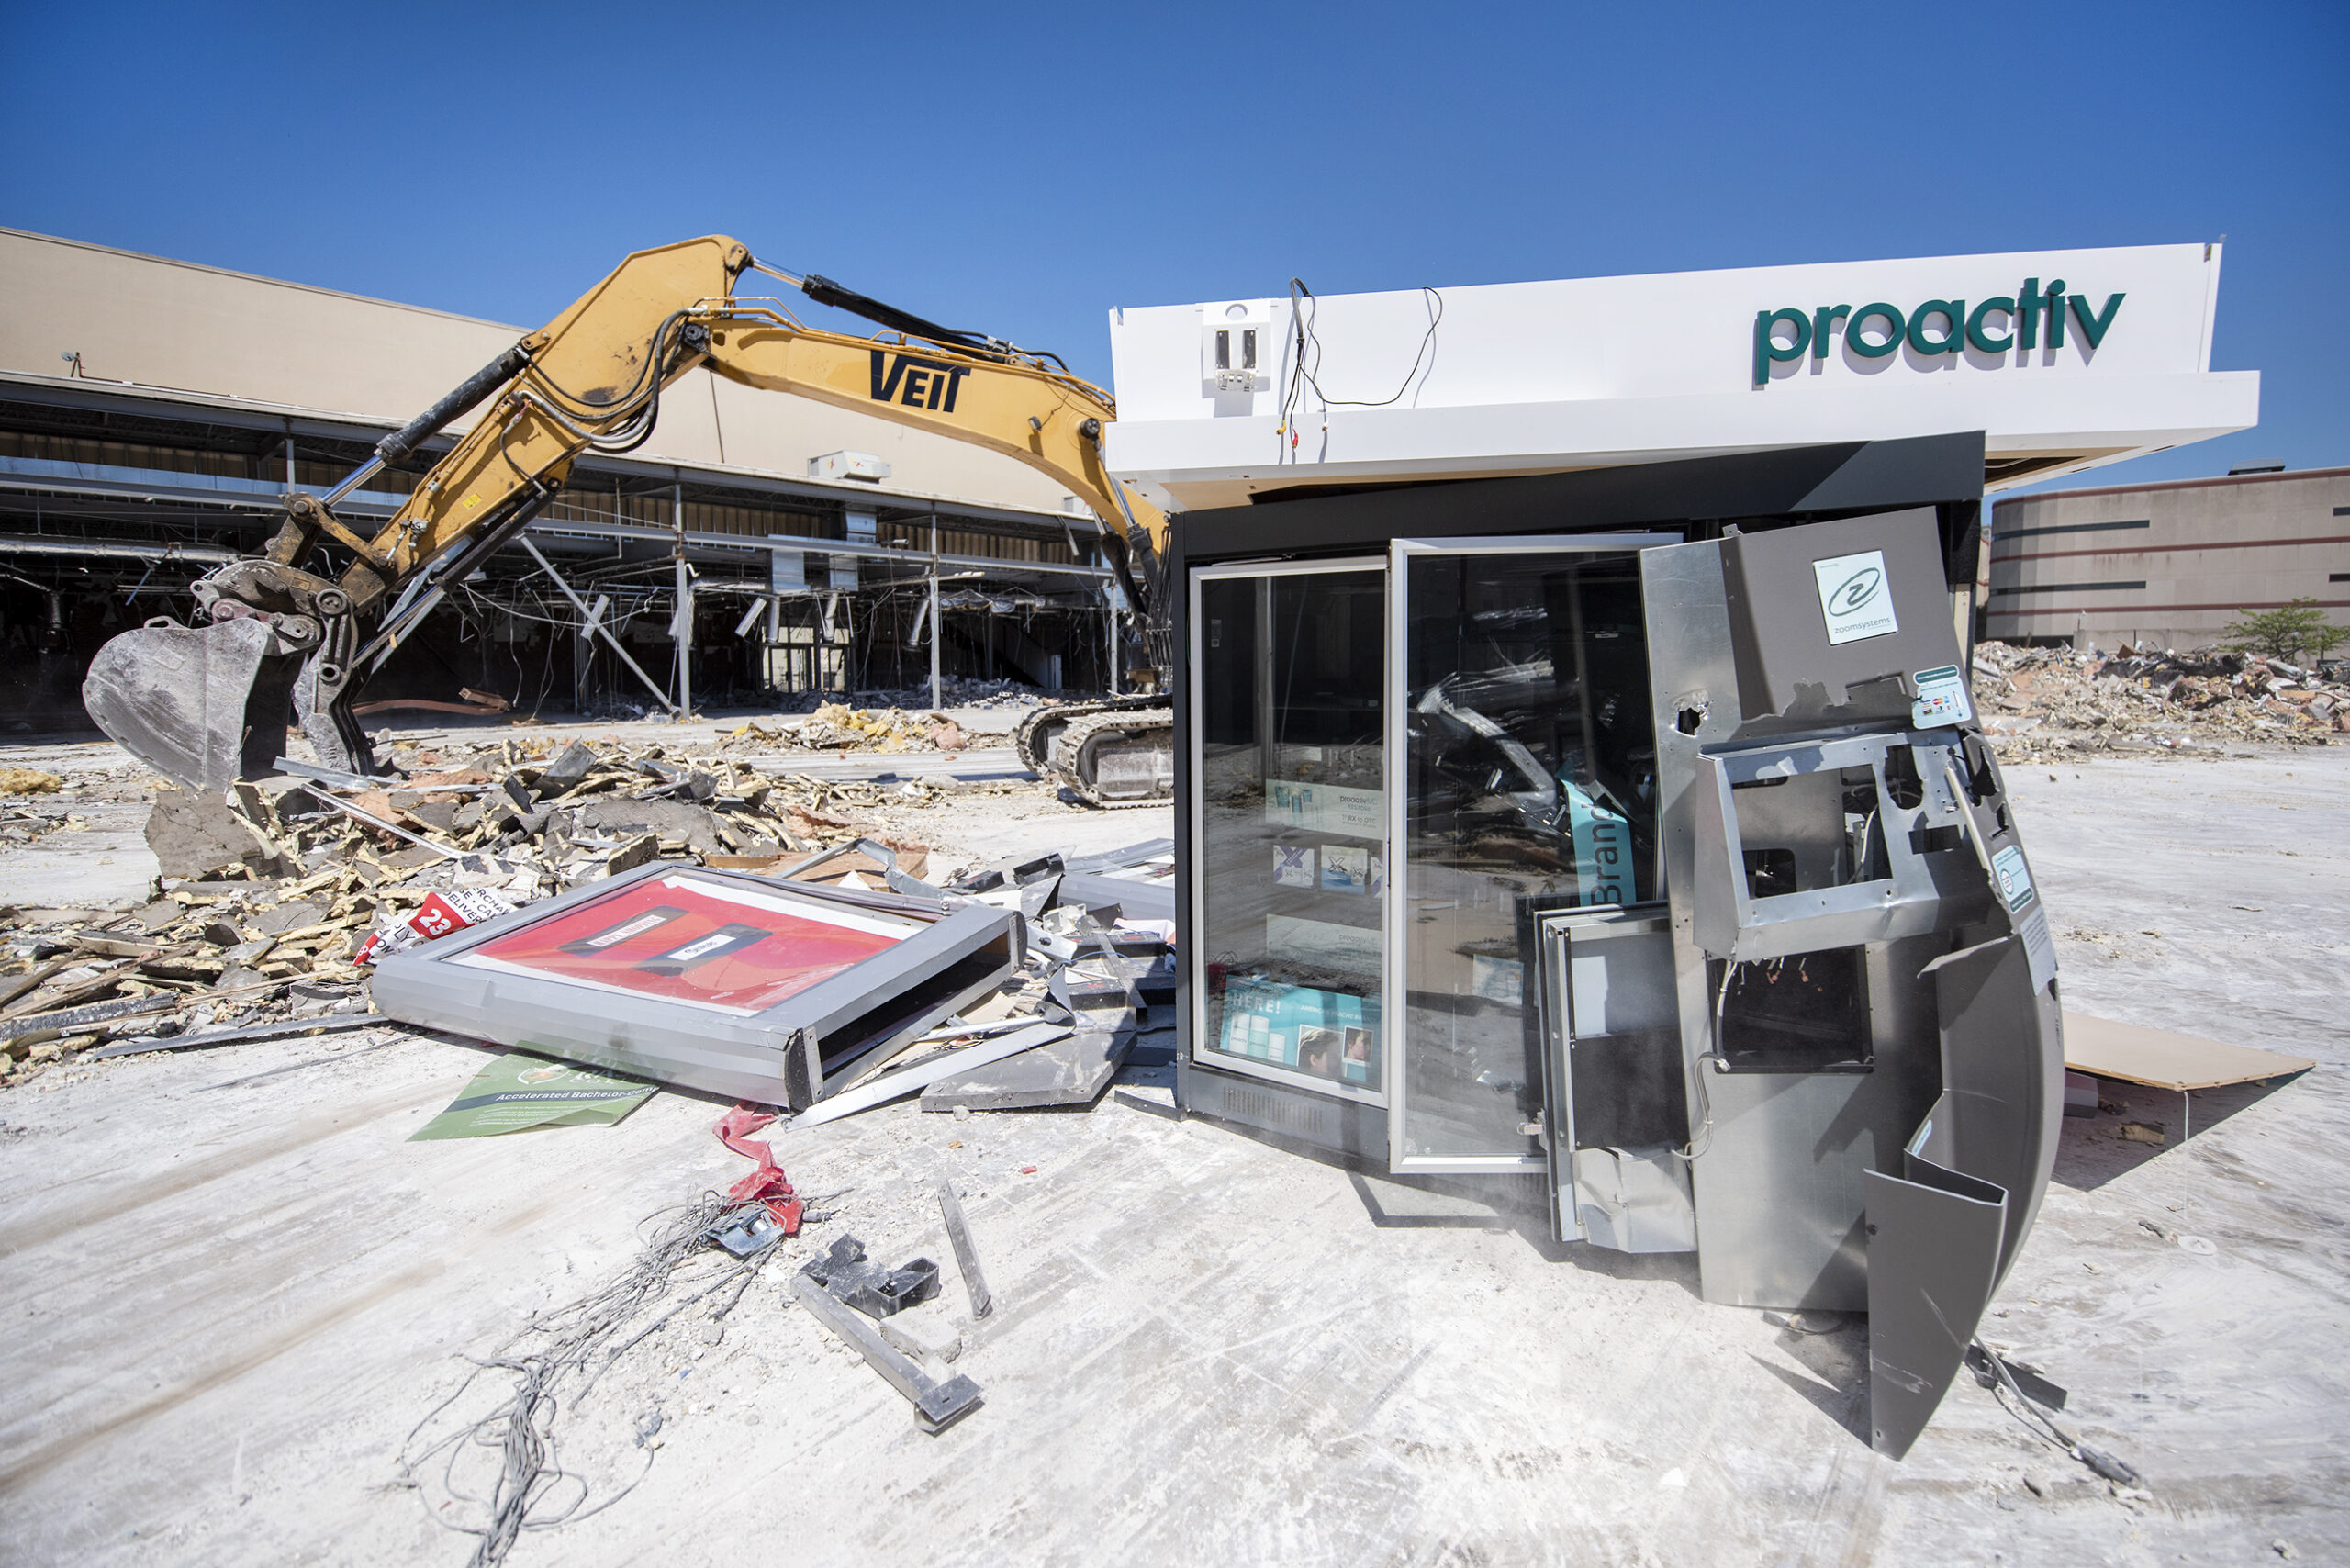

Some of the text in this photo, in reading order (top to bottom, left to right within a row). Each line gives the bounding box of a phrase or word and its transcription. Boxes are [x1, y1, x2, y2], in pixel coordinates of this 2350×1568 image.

[1755, 277, 2127, 385] proactiv
[870, 350, 971, 413] VEIT
[1834, 616, 1891, 634] zoomsystems
[1581, 803, 1623, 906] Brand
[418, 908, 452, 935] 23
[1233, 992, 1281, 1014] HERE!
[496, 1092, 570, 1101] Accelerated
